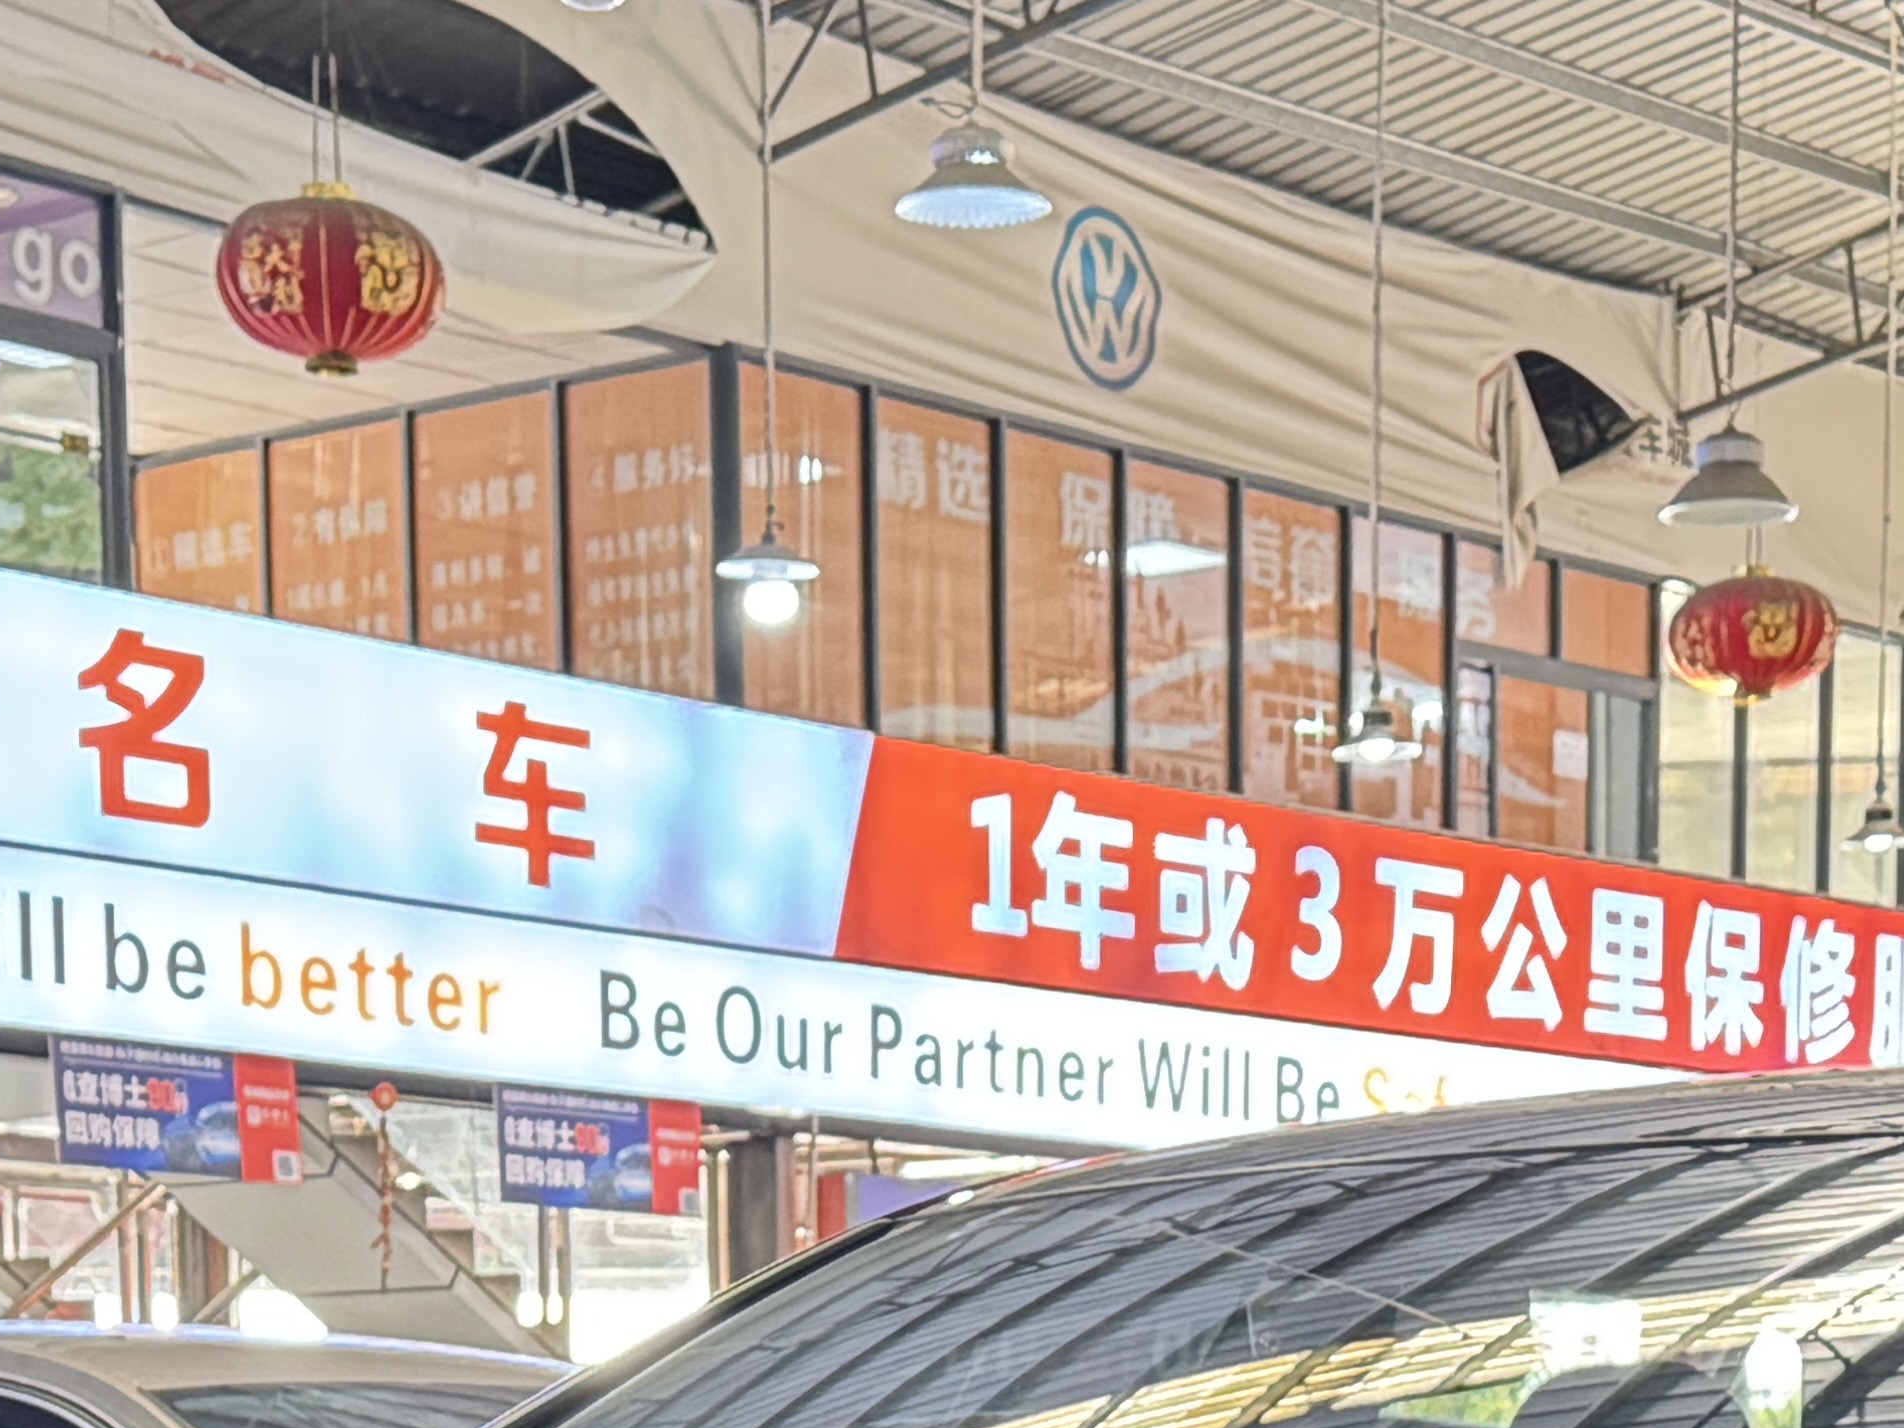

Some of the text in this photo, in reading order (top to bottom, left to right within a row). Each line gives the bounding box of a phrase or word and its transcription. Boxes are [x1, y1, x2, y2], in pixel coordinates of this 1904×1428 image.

[103, 902, 207, 1003] be
[239, 921, 502, 1034] better
[599, 969, 687, 1057] Be
[715, 985, 843, 1074] Our
[868, 1004, 1114, 1112] Partner
[1137, 1037, 1252, 1122] Will
[1277, 1056, 1339, 1124] Be
